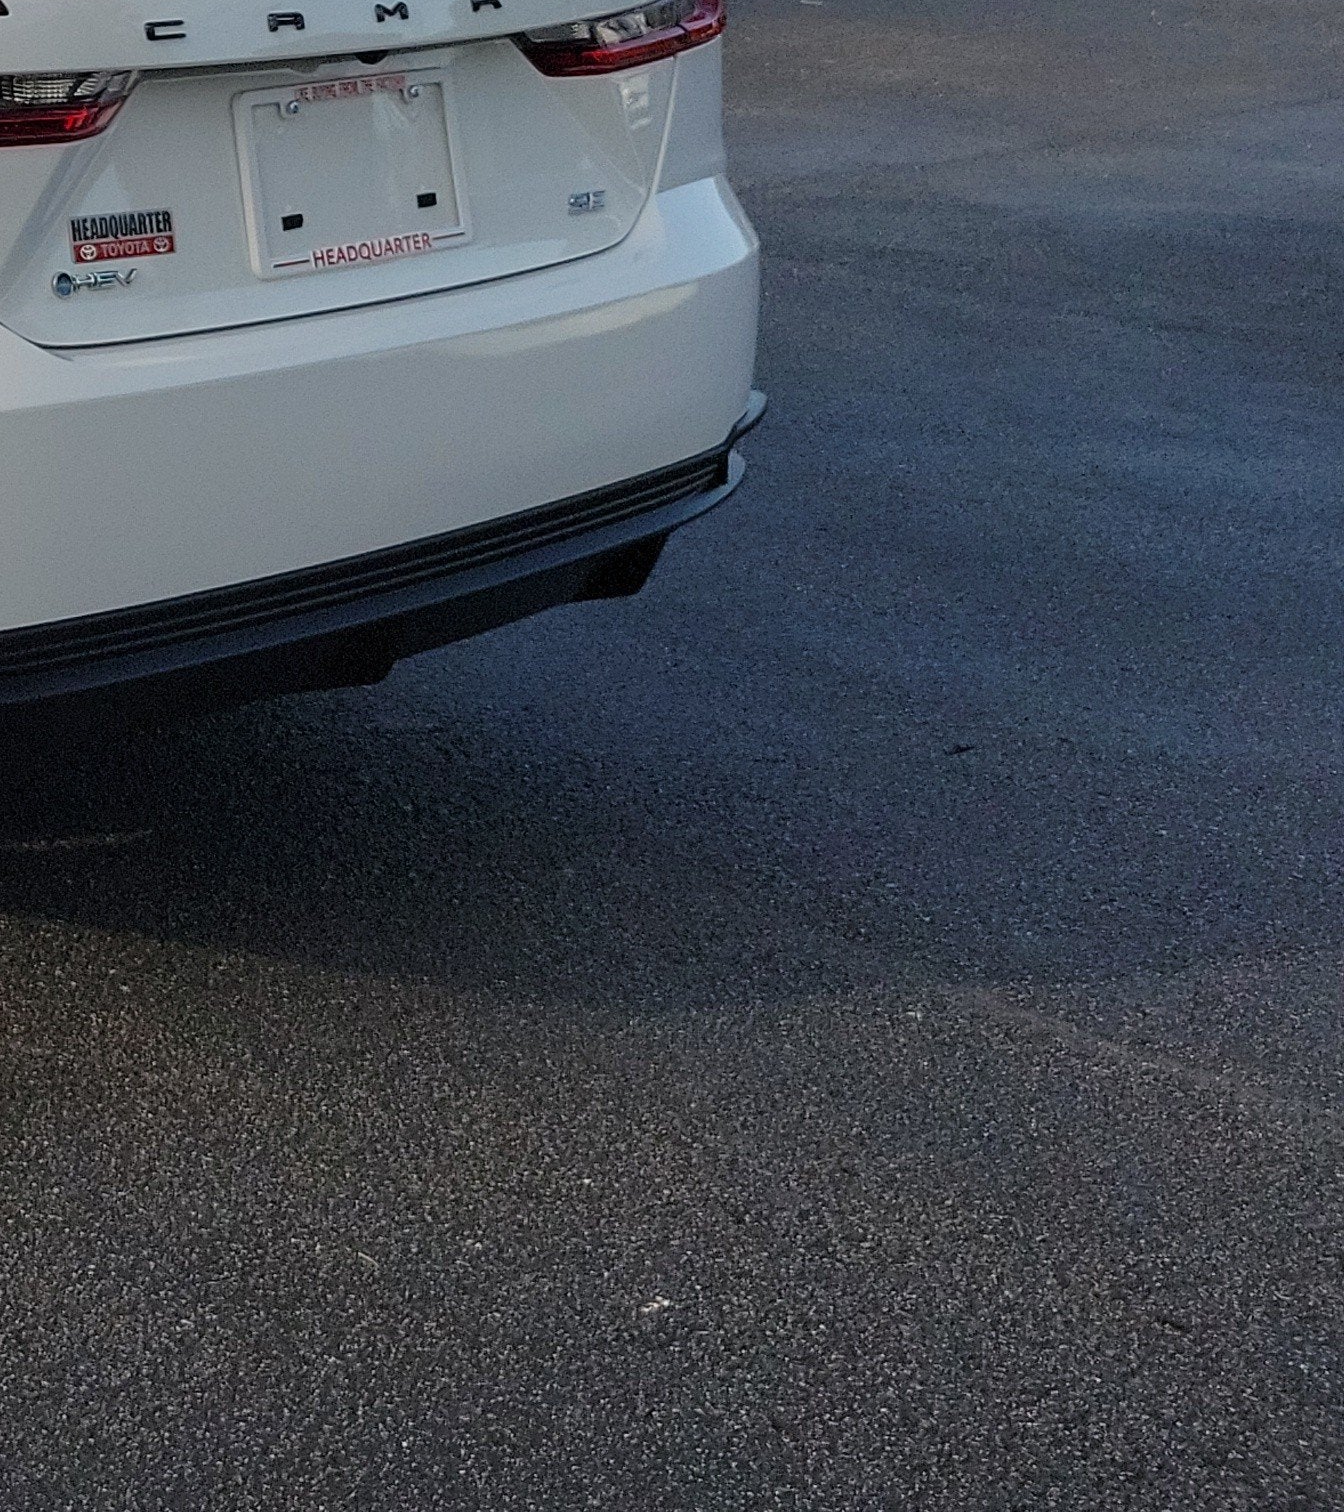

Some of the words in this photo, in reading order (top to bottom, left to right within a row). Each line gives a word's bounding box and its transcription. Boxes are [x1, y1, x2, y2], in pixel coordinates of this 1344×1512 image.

[71, 210, 173, 242] HEADQUARTER
[100, 241, 150, 258] TOYOTA
[313, 232, 433, 268] HEADQUARTER
